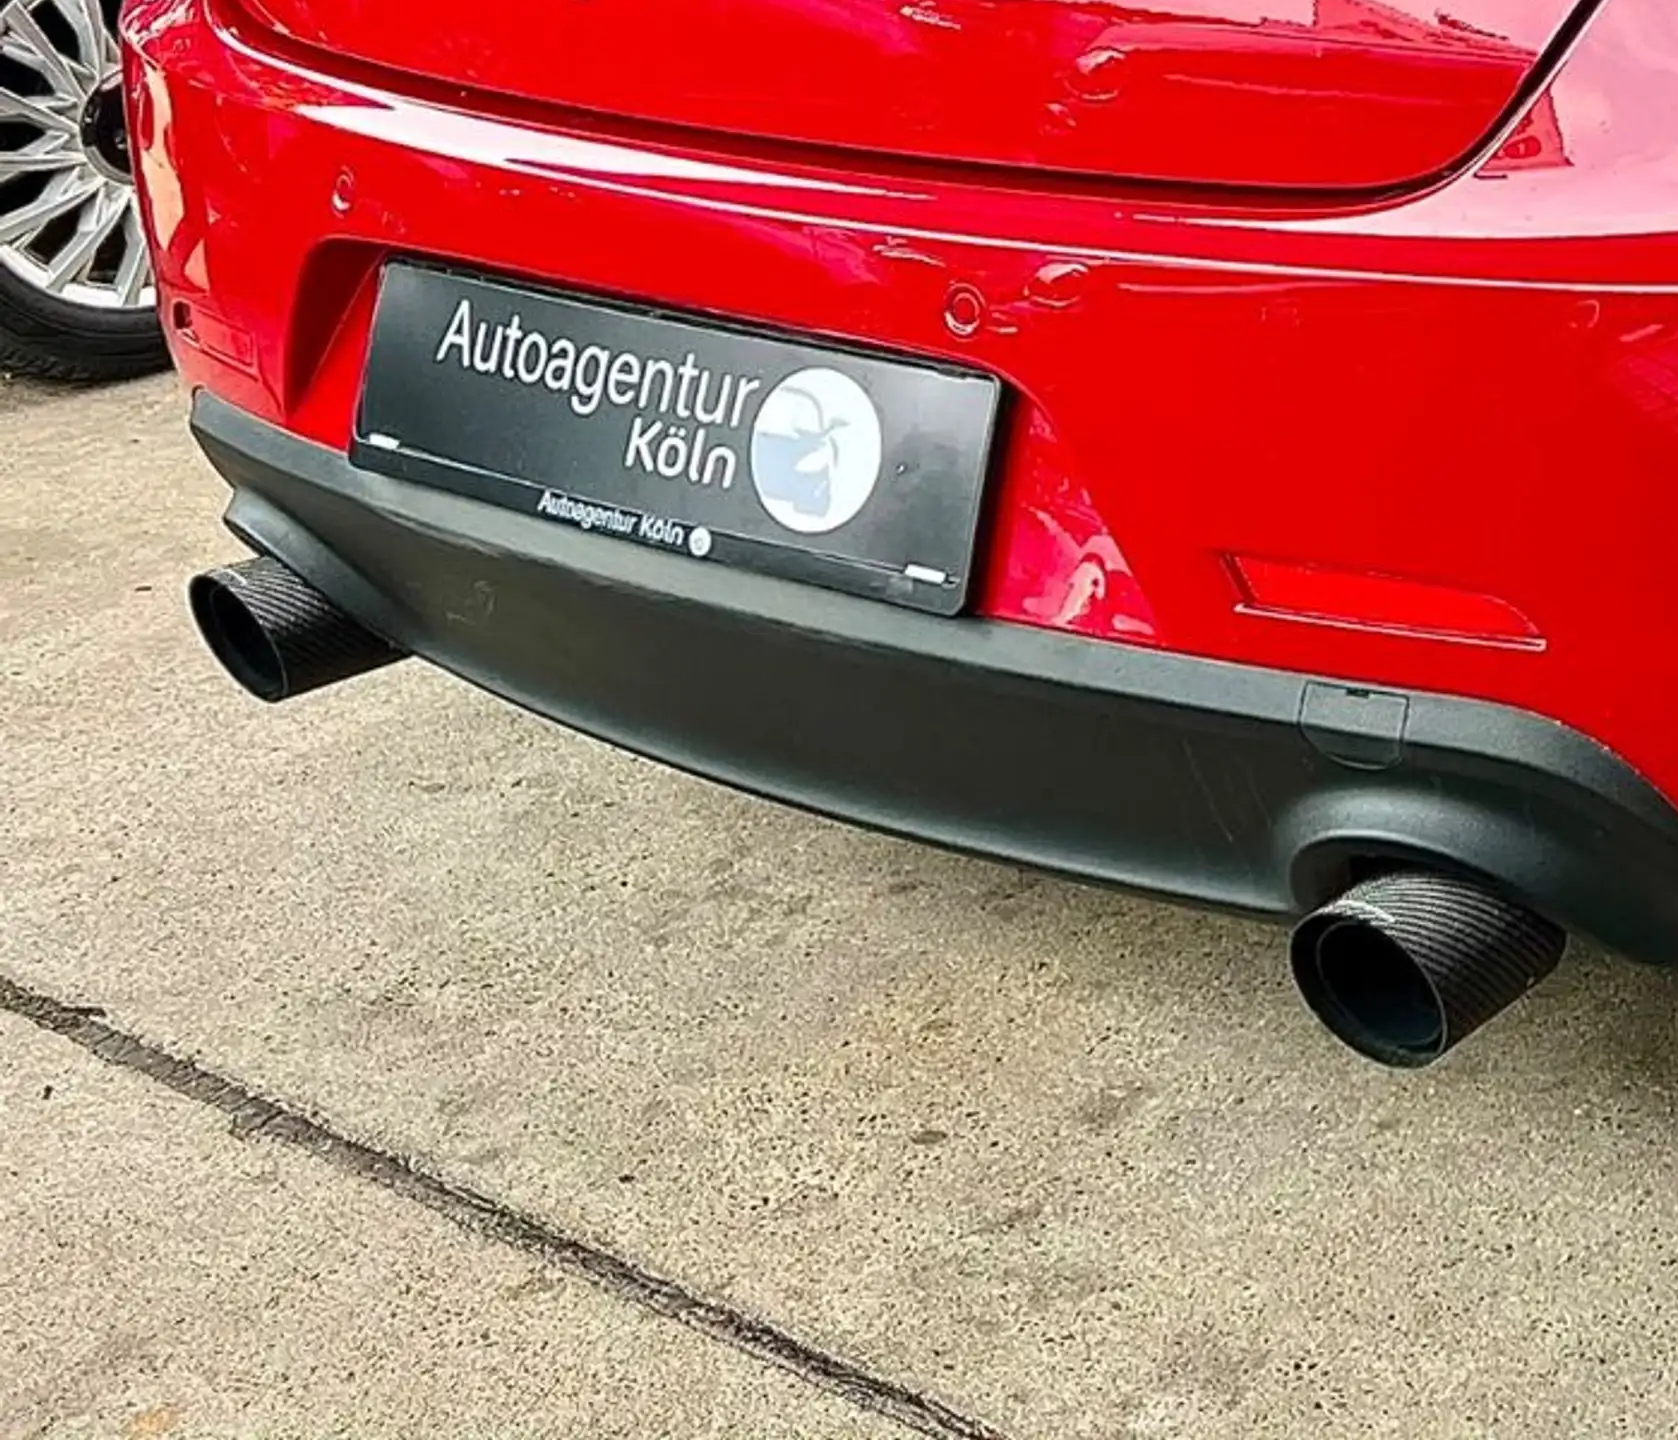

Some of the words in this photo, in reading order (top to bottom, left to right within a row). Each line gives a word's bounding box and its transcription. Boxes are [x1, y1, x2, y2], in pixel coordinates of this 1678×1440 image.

[436, 300, 761, 430] Autoagentur
[625, 418, 737, 490] Köln
[537, 490, 639, 534] Autoagentur
[640, 514, 684, 546] Köln
